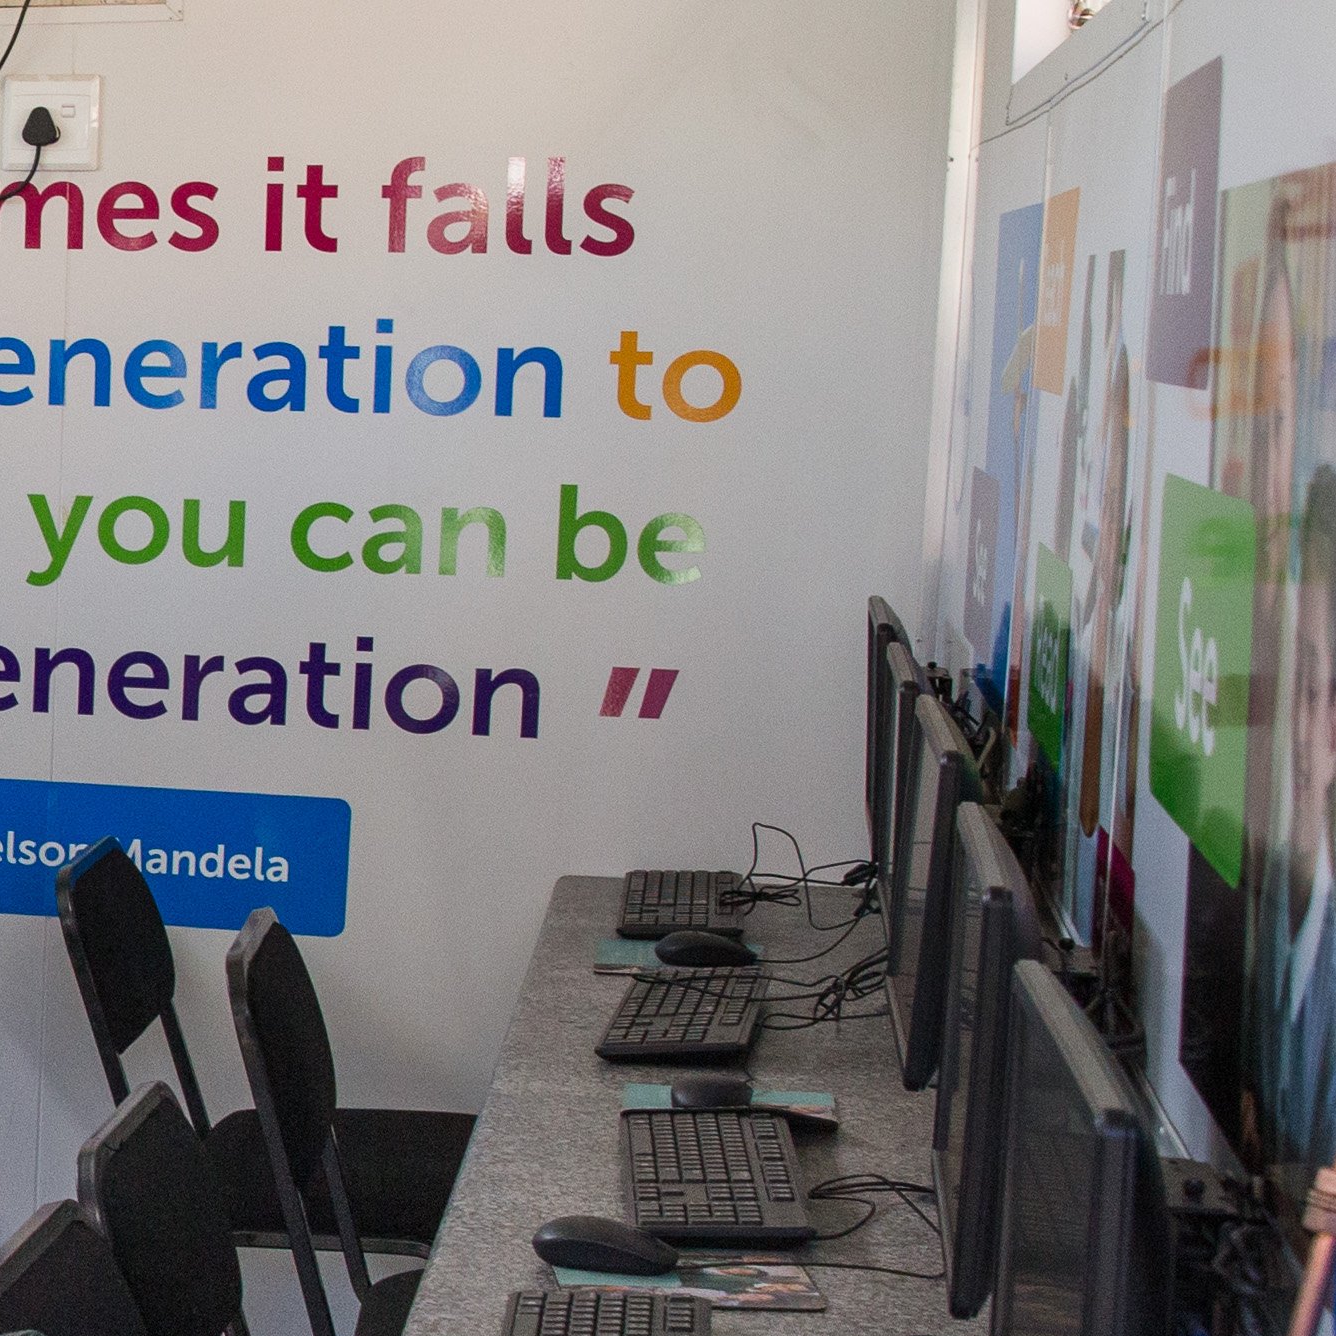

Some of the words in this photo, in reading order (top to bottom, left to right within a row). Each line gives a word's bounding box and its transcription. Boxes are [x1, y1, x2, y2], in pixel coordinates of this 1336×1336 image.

[263, 156, 339, 254] it
[381, 155, 636, 257] falls
[608, 330, 743, 424] to
[25, 493, 247, 588] you
[289, 500, 508, 579] can
[554, 483, 707, 588] be
[1175, 576, 1219, 758] See
